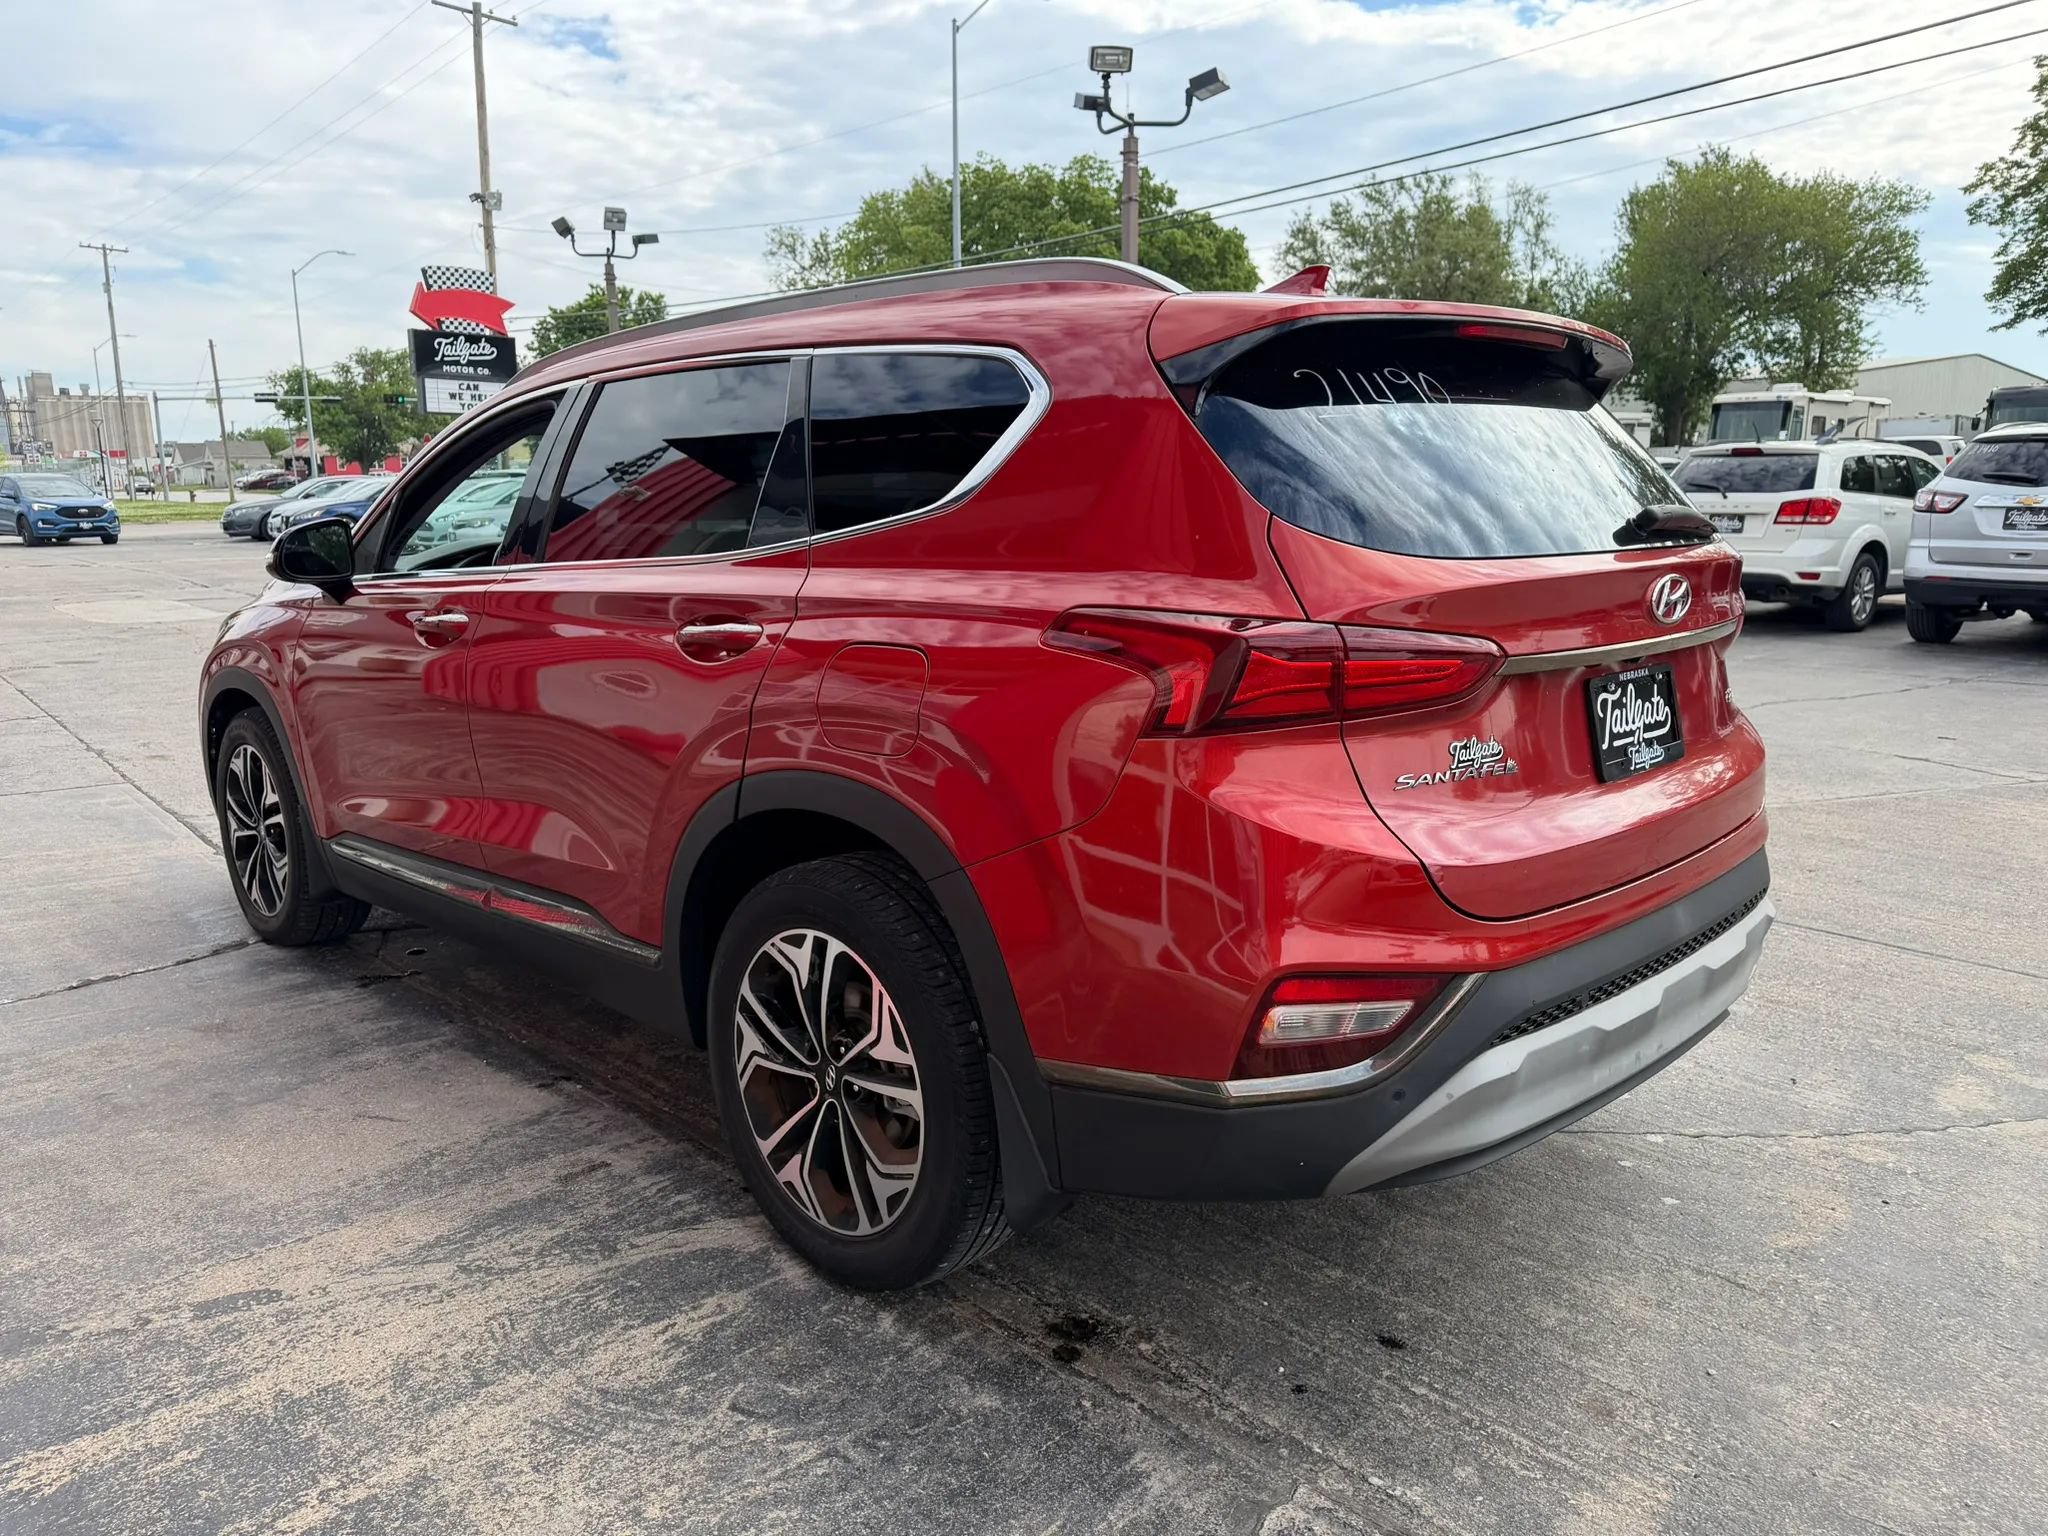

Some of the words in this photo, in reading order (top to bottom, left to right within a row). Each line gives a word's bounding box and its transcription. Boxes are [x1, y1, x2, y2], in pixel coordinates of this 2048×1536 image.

[434, 336, 497, 364] Tailgate
[443, 365, 474, 374] MOTOR
[458, 383, 479, 391] CAN
[448, 392, 464, 401] WE
[459, 403, 477, 411] YO
[1619, 668, 1649, 681] NEBRASKA
[1597, 683, 1671, 750] Tailgate
[1450, 735, 1504, 769] Tailgate
[1628, 739, 1664, 770] Tailgate
